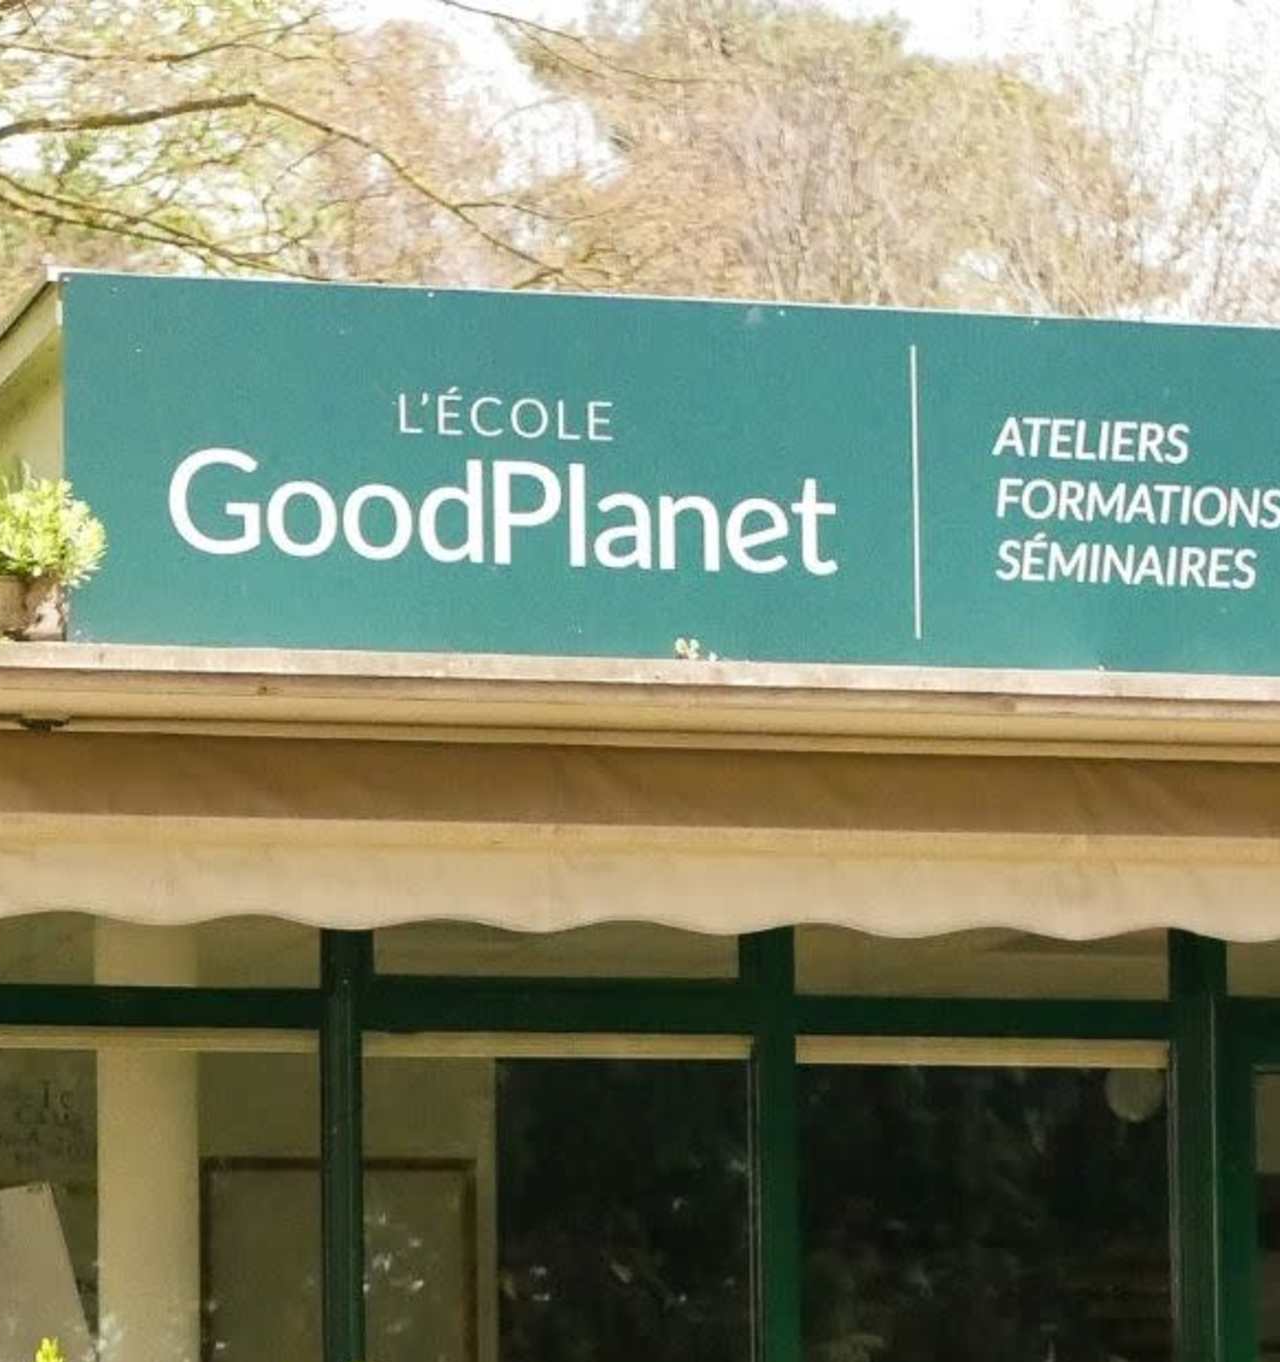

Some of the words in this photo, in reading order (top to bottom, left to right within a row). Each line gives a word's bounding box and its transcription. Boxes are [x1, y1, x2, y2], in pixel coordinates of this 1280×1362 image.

[992, 416, 1191, 466] ATELIERS
[169, 448, 839, 577] GoodPlanet
[996, 531, 1258, 591] SÉMINAIRES
